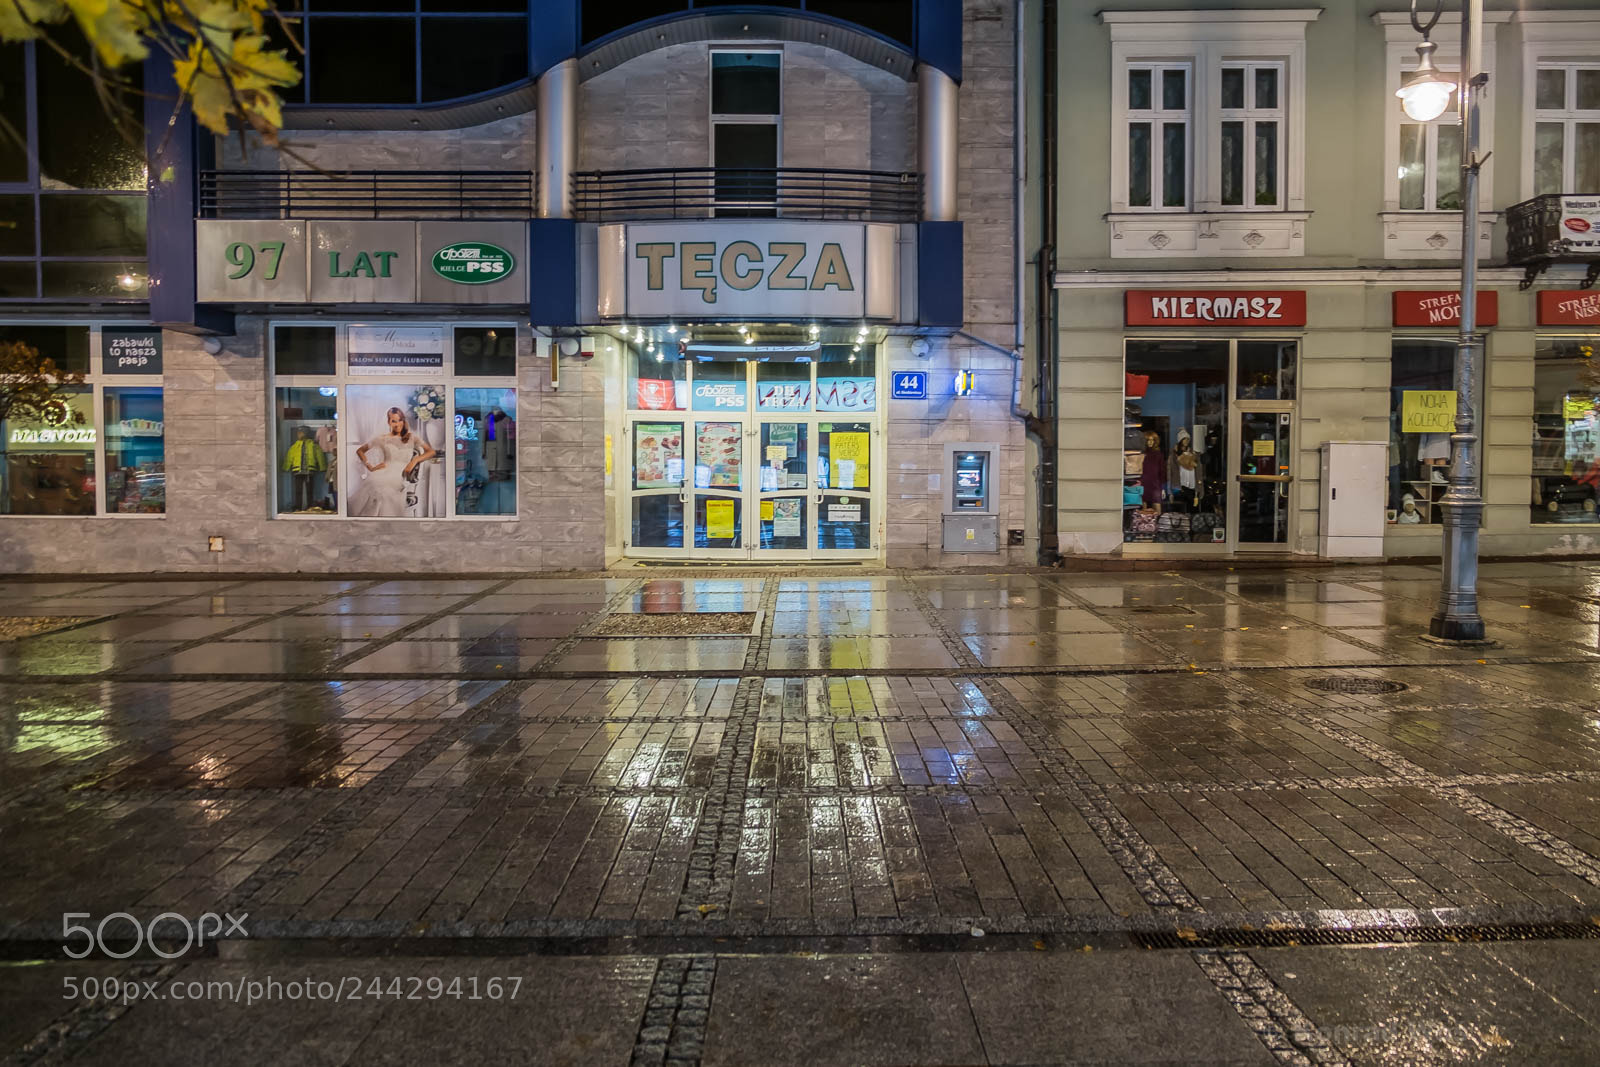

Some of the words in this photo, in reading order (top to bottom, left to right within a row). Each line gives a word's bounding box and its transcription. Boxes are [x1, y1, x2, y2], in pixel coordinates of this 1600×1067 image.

[225, 241, 286, 280] 97
[328, 251, 398, 278] LAT
[466, 261, 505, 273] PSS
[636, 240, 855, 303] TĘCZA
[1152, 297, 1282, 321] KIERMASZ
[1419, 293, 1462, 311] STREFA
[1558, 294, 1600, 313] STREF
[112, 337, 154, 347] zabawki
[109, 347, 121, 356] to
[125, 348, 157, 356] nasza
[118, 355, 148, 367] pasja
[900, 375, 918, 389] 44
[715, 396, 745, 407] PSS
[1420, 394, 1449, 409] NOWA
